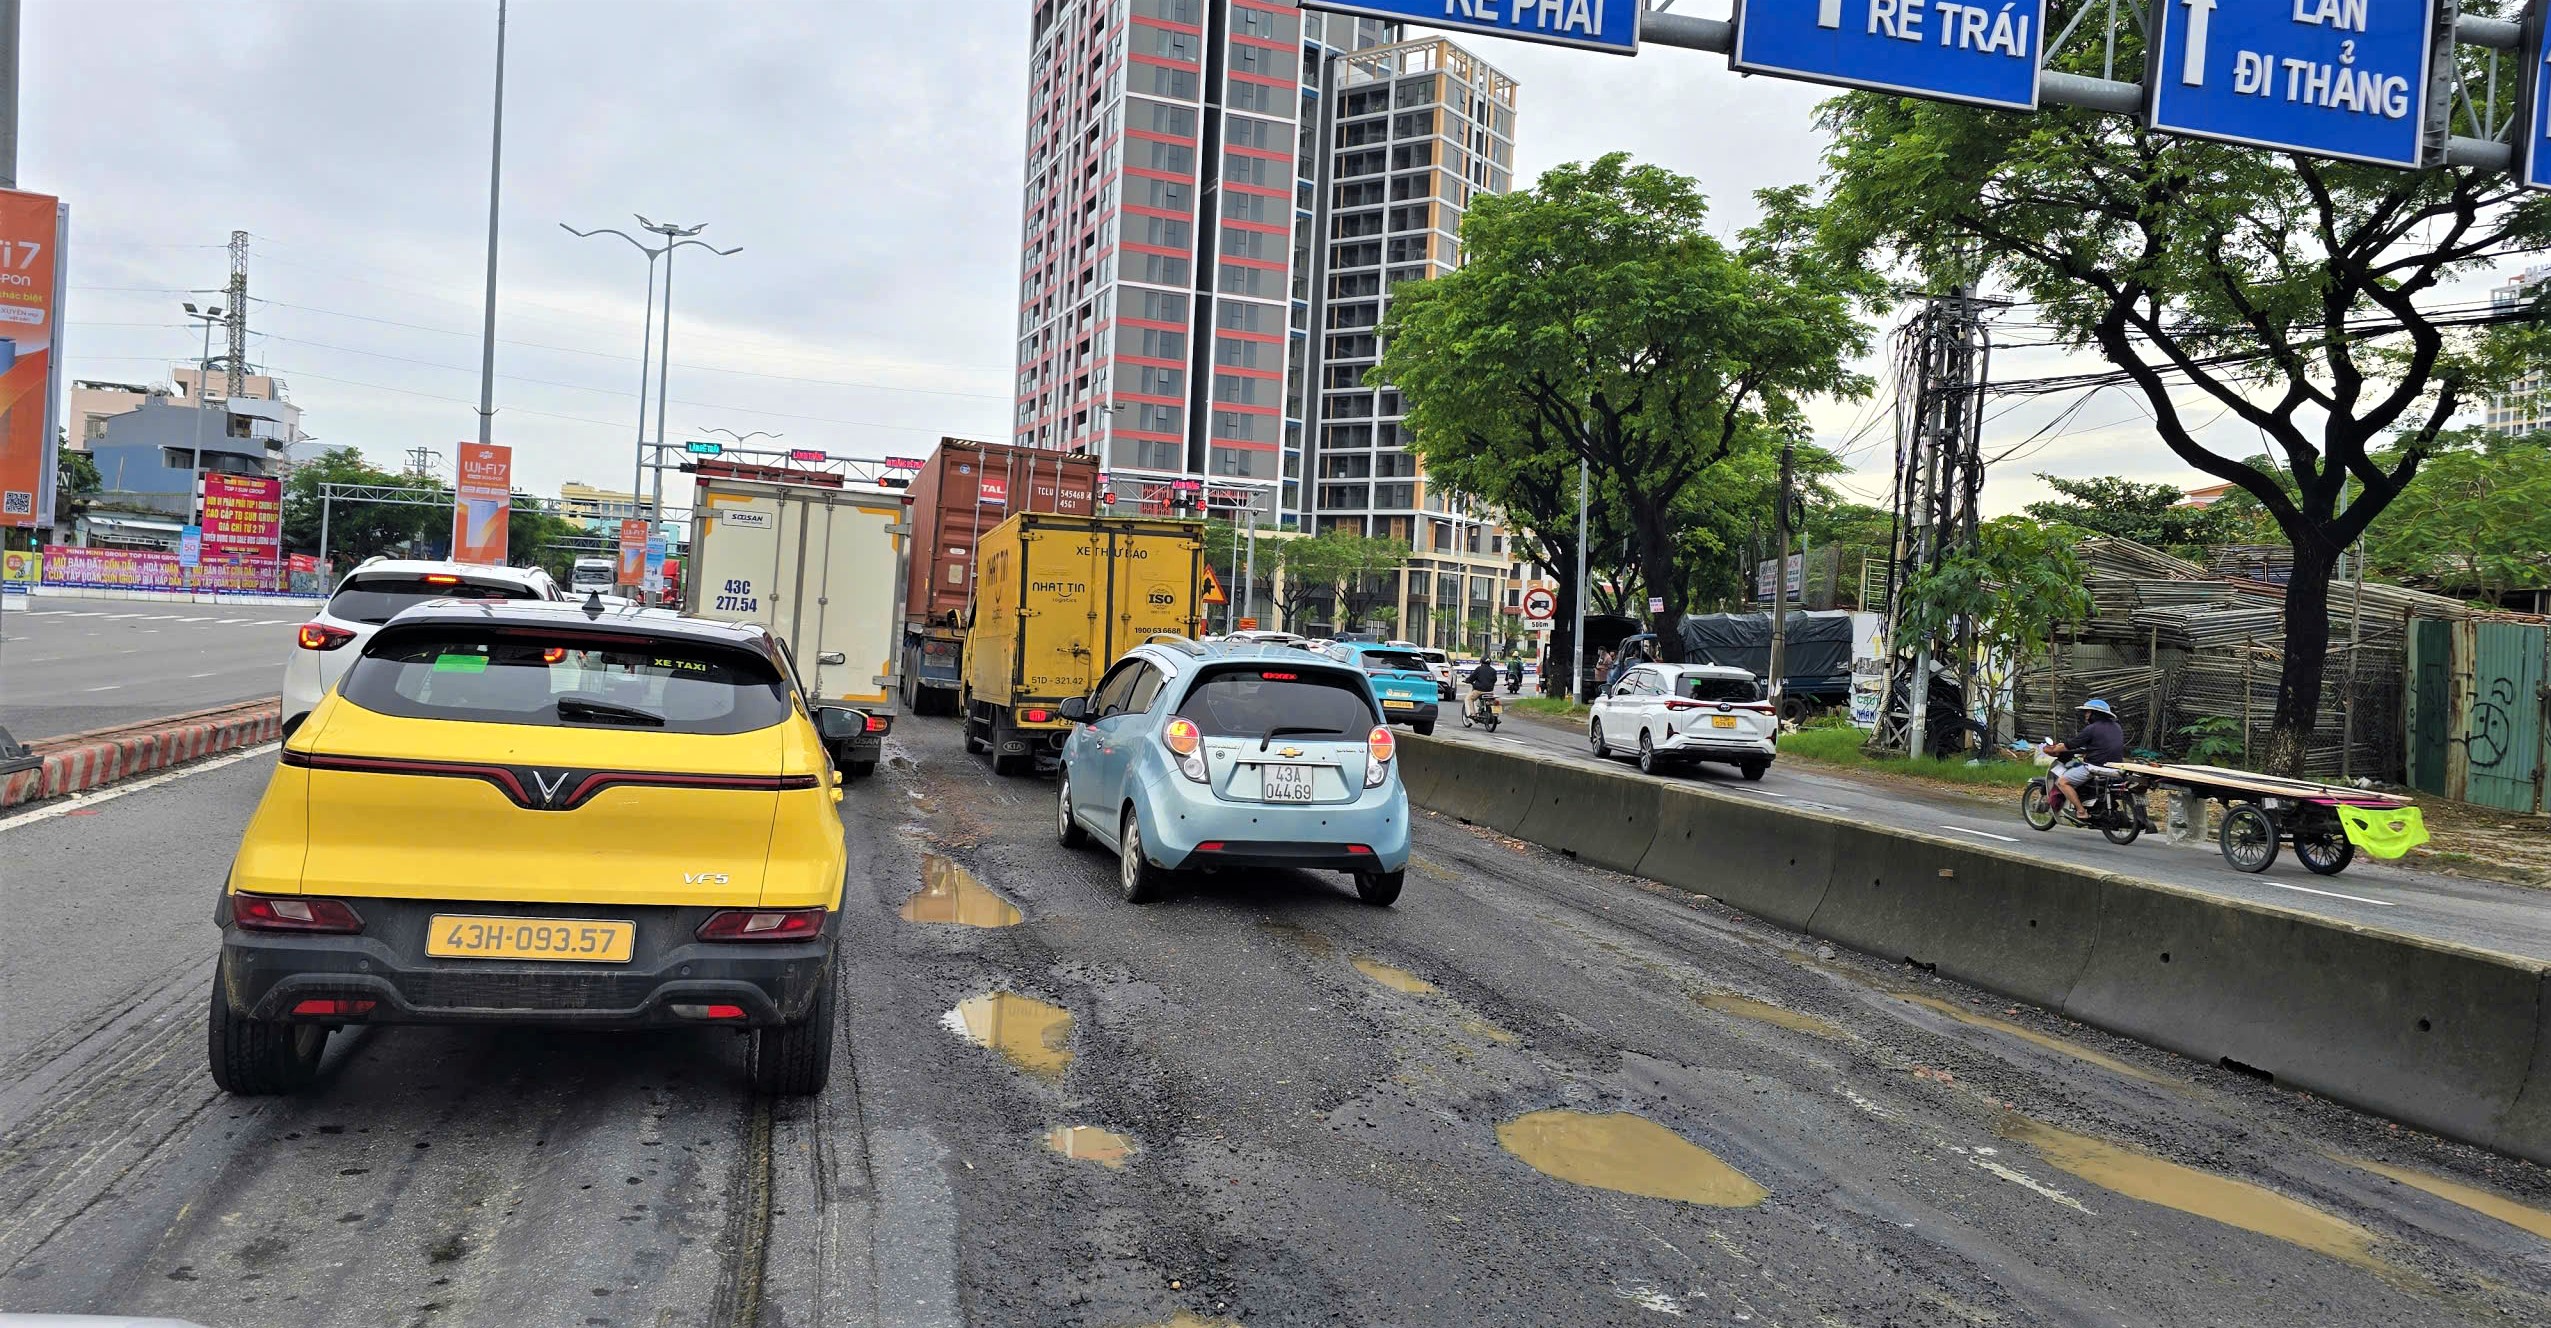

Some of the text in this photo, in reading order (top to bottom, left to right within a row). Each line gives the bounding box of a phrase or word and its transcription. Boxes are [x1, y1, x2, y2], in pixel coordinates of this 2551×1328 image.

[1935, 2, 2029, 58] TRÁI
[2233, 50, 2274, 97] ĐI
[18, 241, 41, 270] 7
[498, 463, 507, 476] 7
[981, 484, 1005, 494] TAL
[1038, 486, 1054, 497] TCLU
[1060, 499, 1076, 509] 45G1
[205, 508, 219, 519] CAO
[220, 507, 234, 520] CẤP
[244, 511, 257, 521] SUN
[258, 512, 279, 523] GROUP
[218, 521, 230, 532] GIÁ
[252, 524, 257, 533] 2
[85, 549, 104, 557] MINH
[105, 550, 128, 558] GROUP
[1076, 546, 1091, 556] XE
[1125, 548, 1148, 560] BÁO
[68, 556, 85, 568] BÁN
[102, 572, 118, 583] SUN
[119, 573, 141, 584] GROUP
[724, 579, 751, 595] 43C
[1032, 581, 1085, 593] NHAT TIN
[716, 595, 758, 612] 277.54
[1148, 593, 1174, 605] ISO
[654, 658, 707, 672] XE TAXI
[1031, 676, 1048, 684] 51D
[1055, 677, 1084, 685] 321.42
[1006, 742, 1022, 750] KIA
[1275, 766, 1302, 783] 43A
[1266, 784, 1312, 800] 044.69
[446, 923, 616, 954] 43H-093.57
